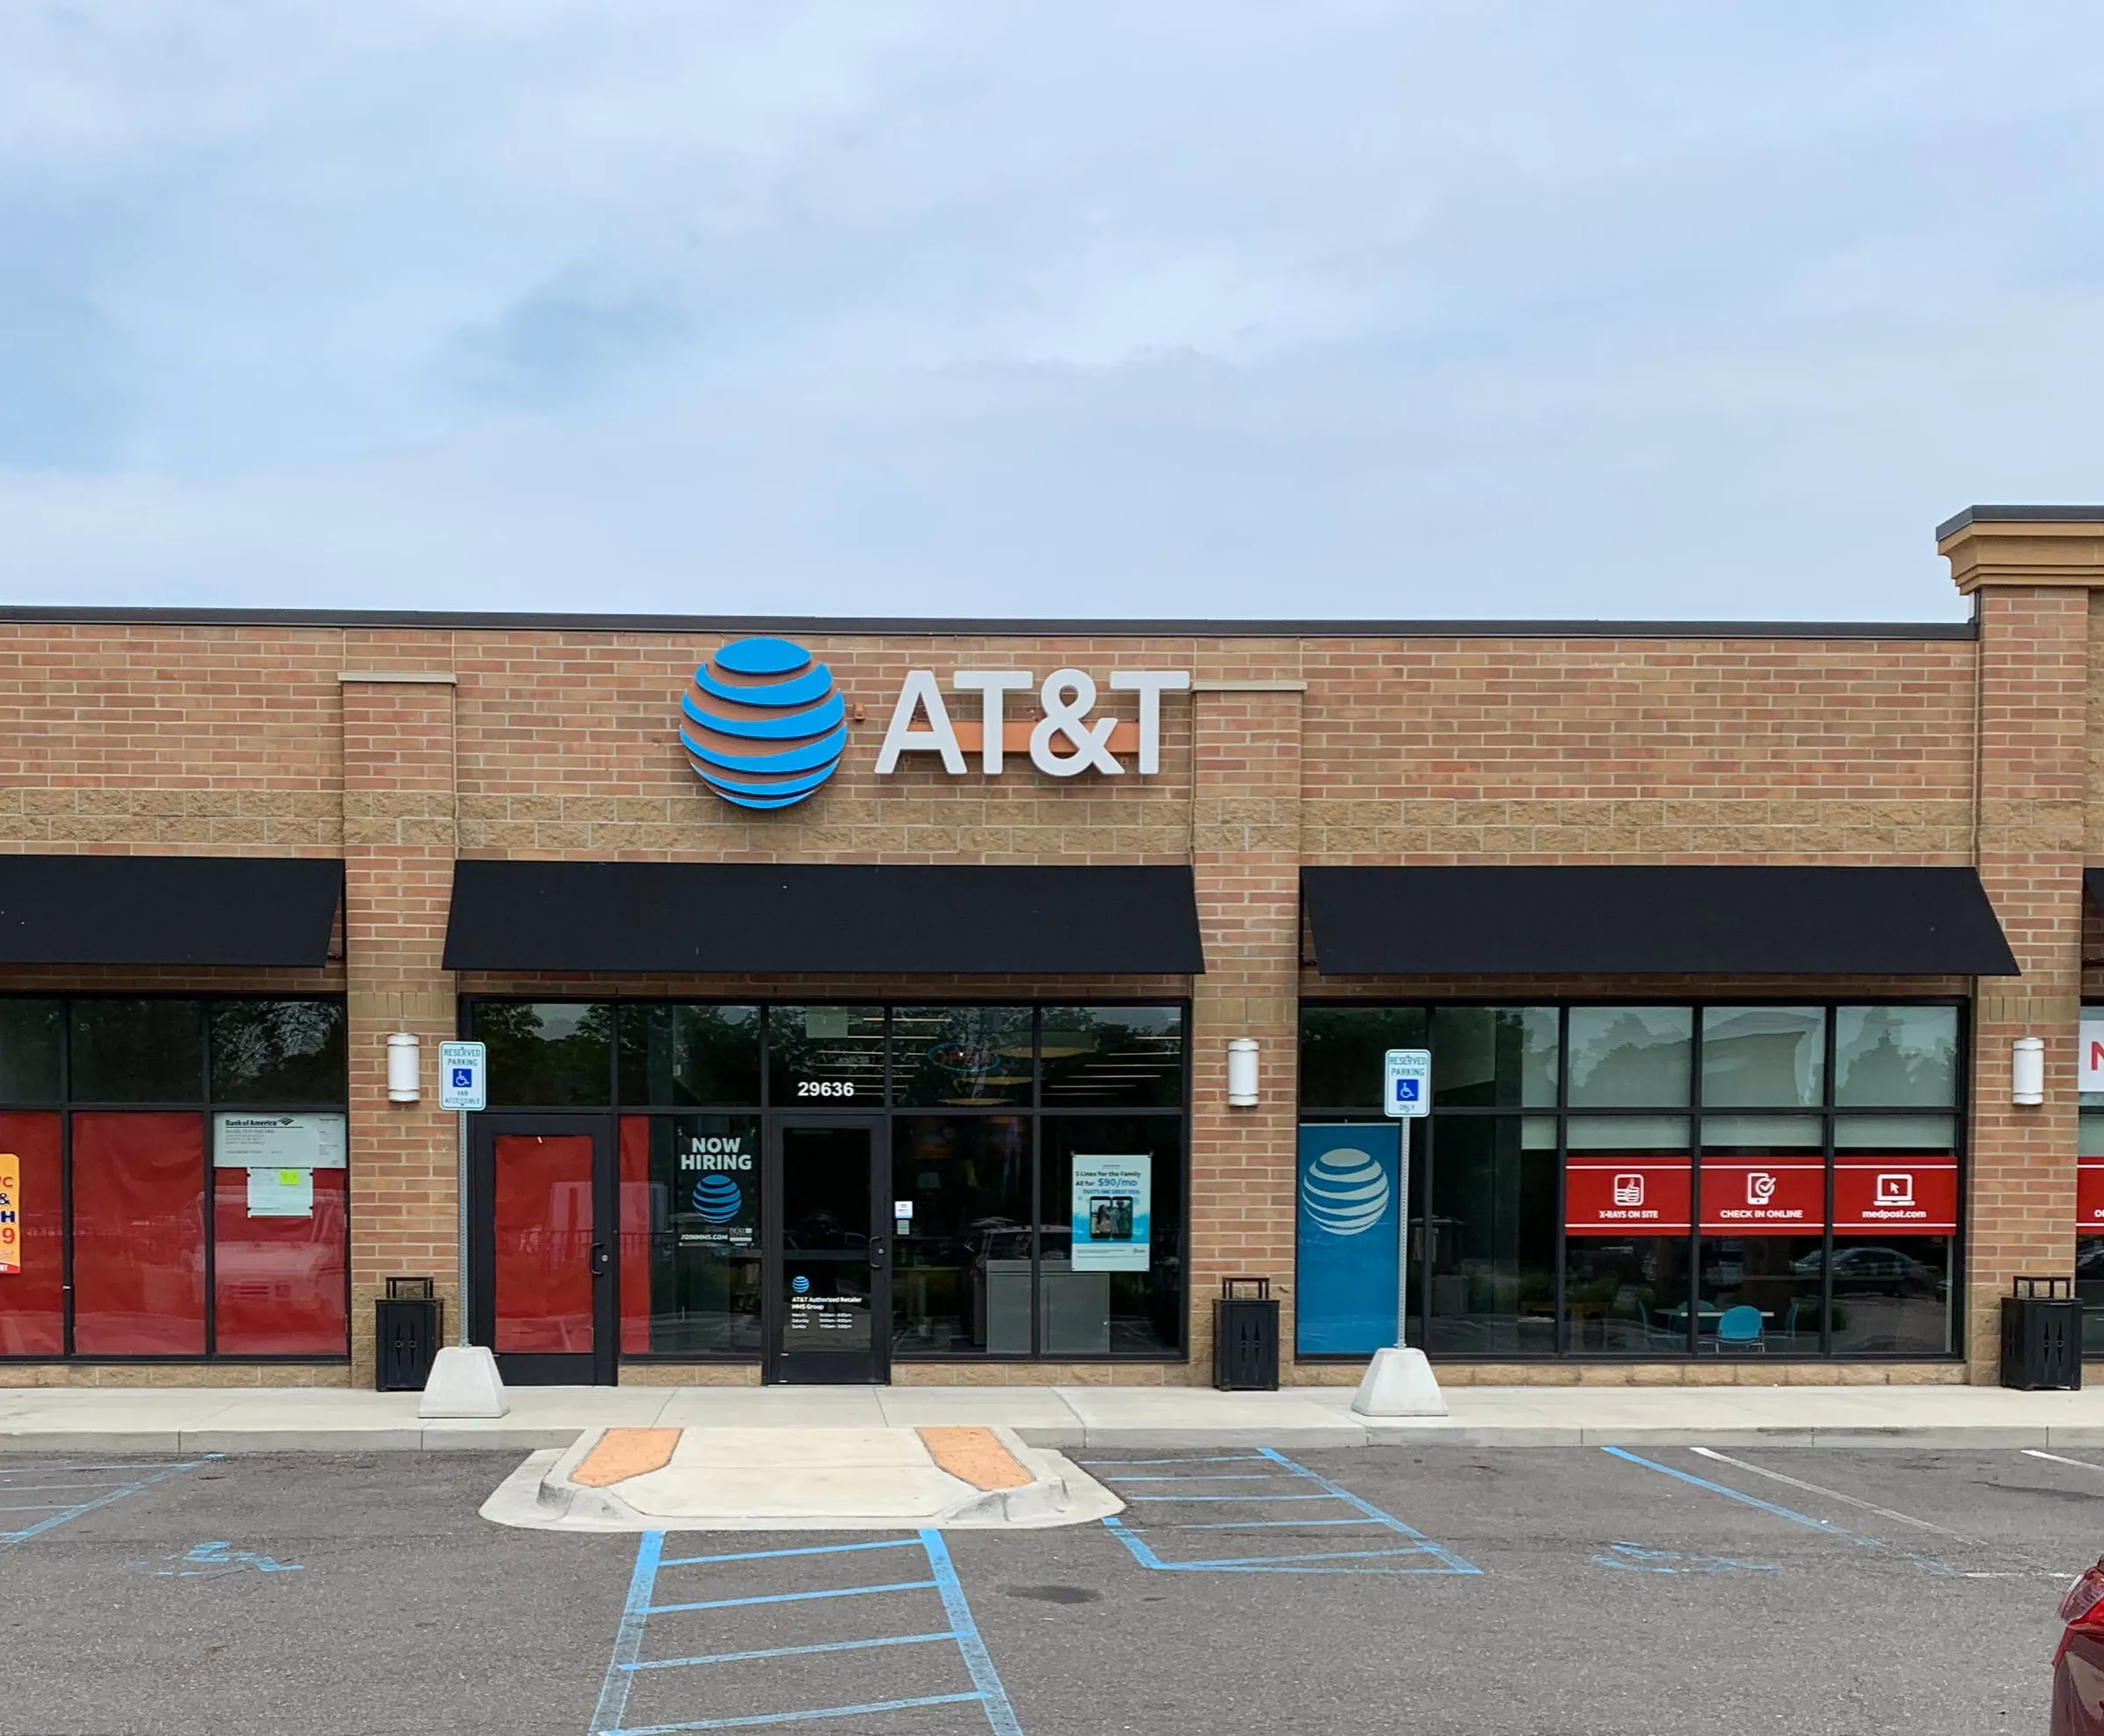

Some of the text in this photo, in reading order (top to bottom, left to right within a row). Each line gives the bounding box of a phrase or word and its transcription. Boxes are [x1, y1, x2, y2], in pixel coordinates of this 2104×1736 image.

[874, 668, 1190, 777] AT&T
[1389, 1057, 1428, 1065] RESERVED
[1392, 1068, 1424, 1077] PARKING
[797, 1081, 855, 1097] 29636
[692, 1137, 741, 1153] NOW
[681, 1154, 752, 1170] HIRING
[1098, 1178, 1138, 1188] $90/mo
[1599, 1209, 1659, 1218] X-RAYS ON SITE
[1720, 1209, 1803, 1218] CHECK IN ONLINE
[1862, 1209, 1927, 1219] medpost.com
